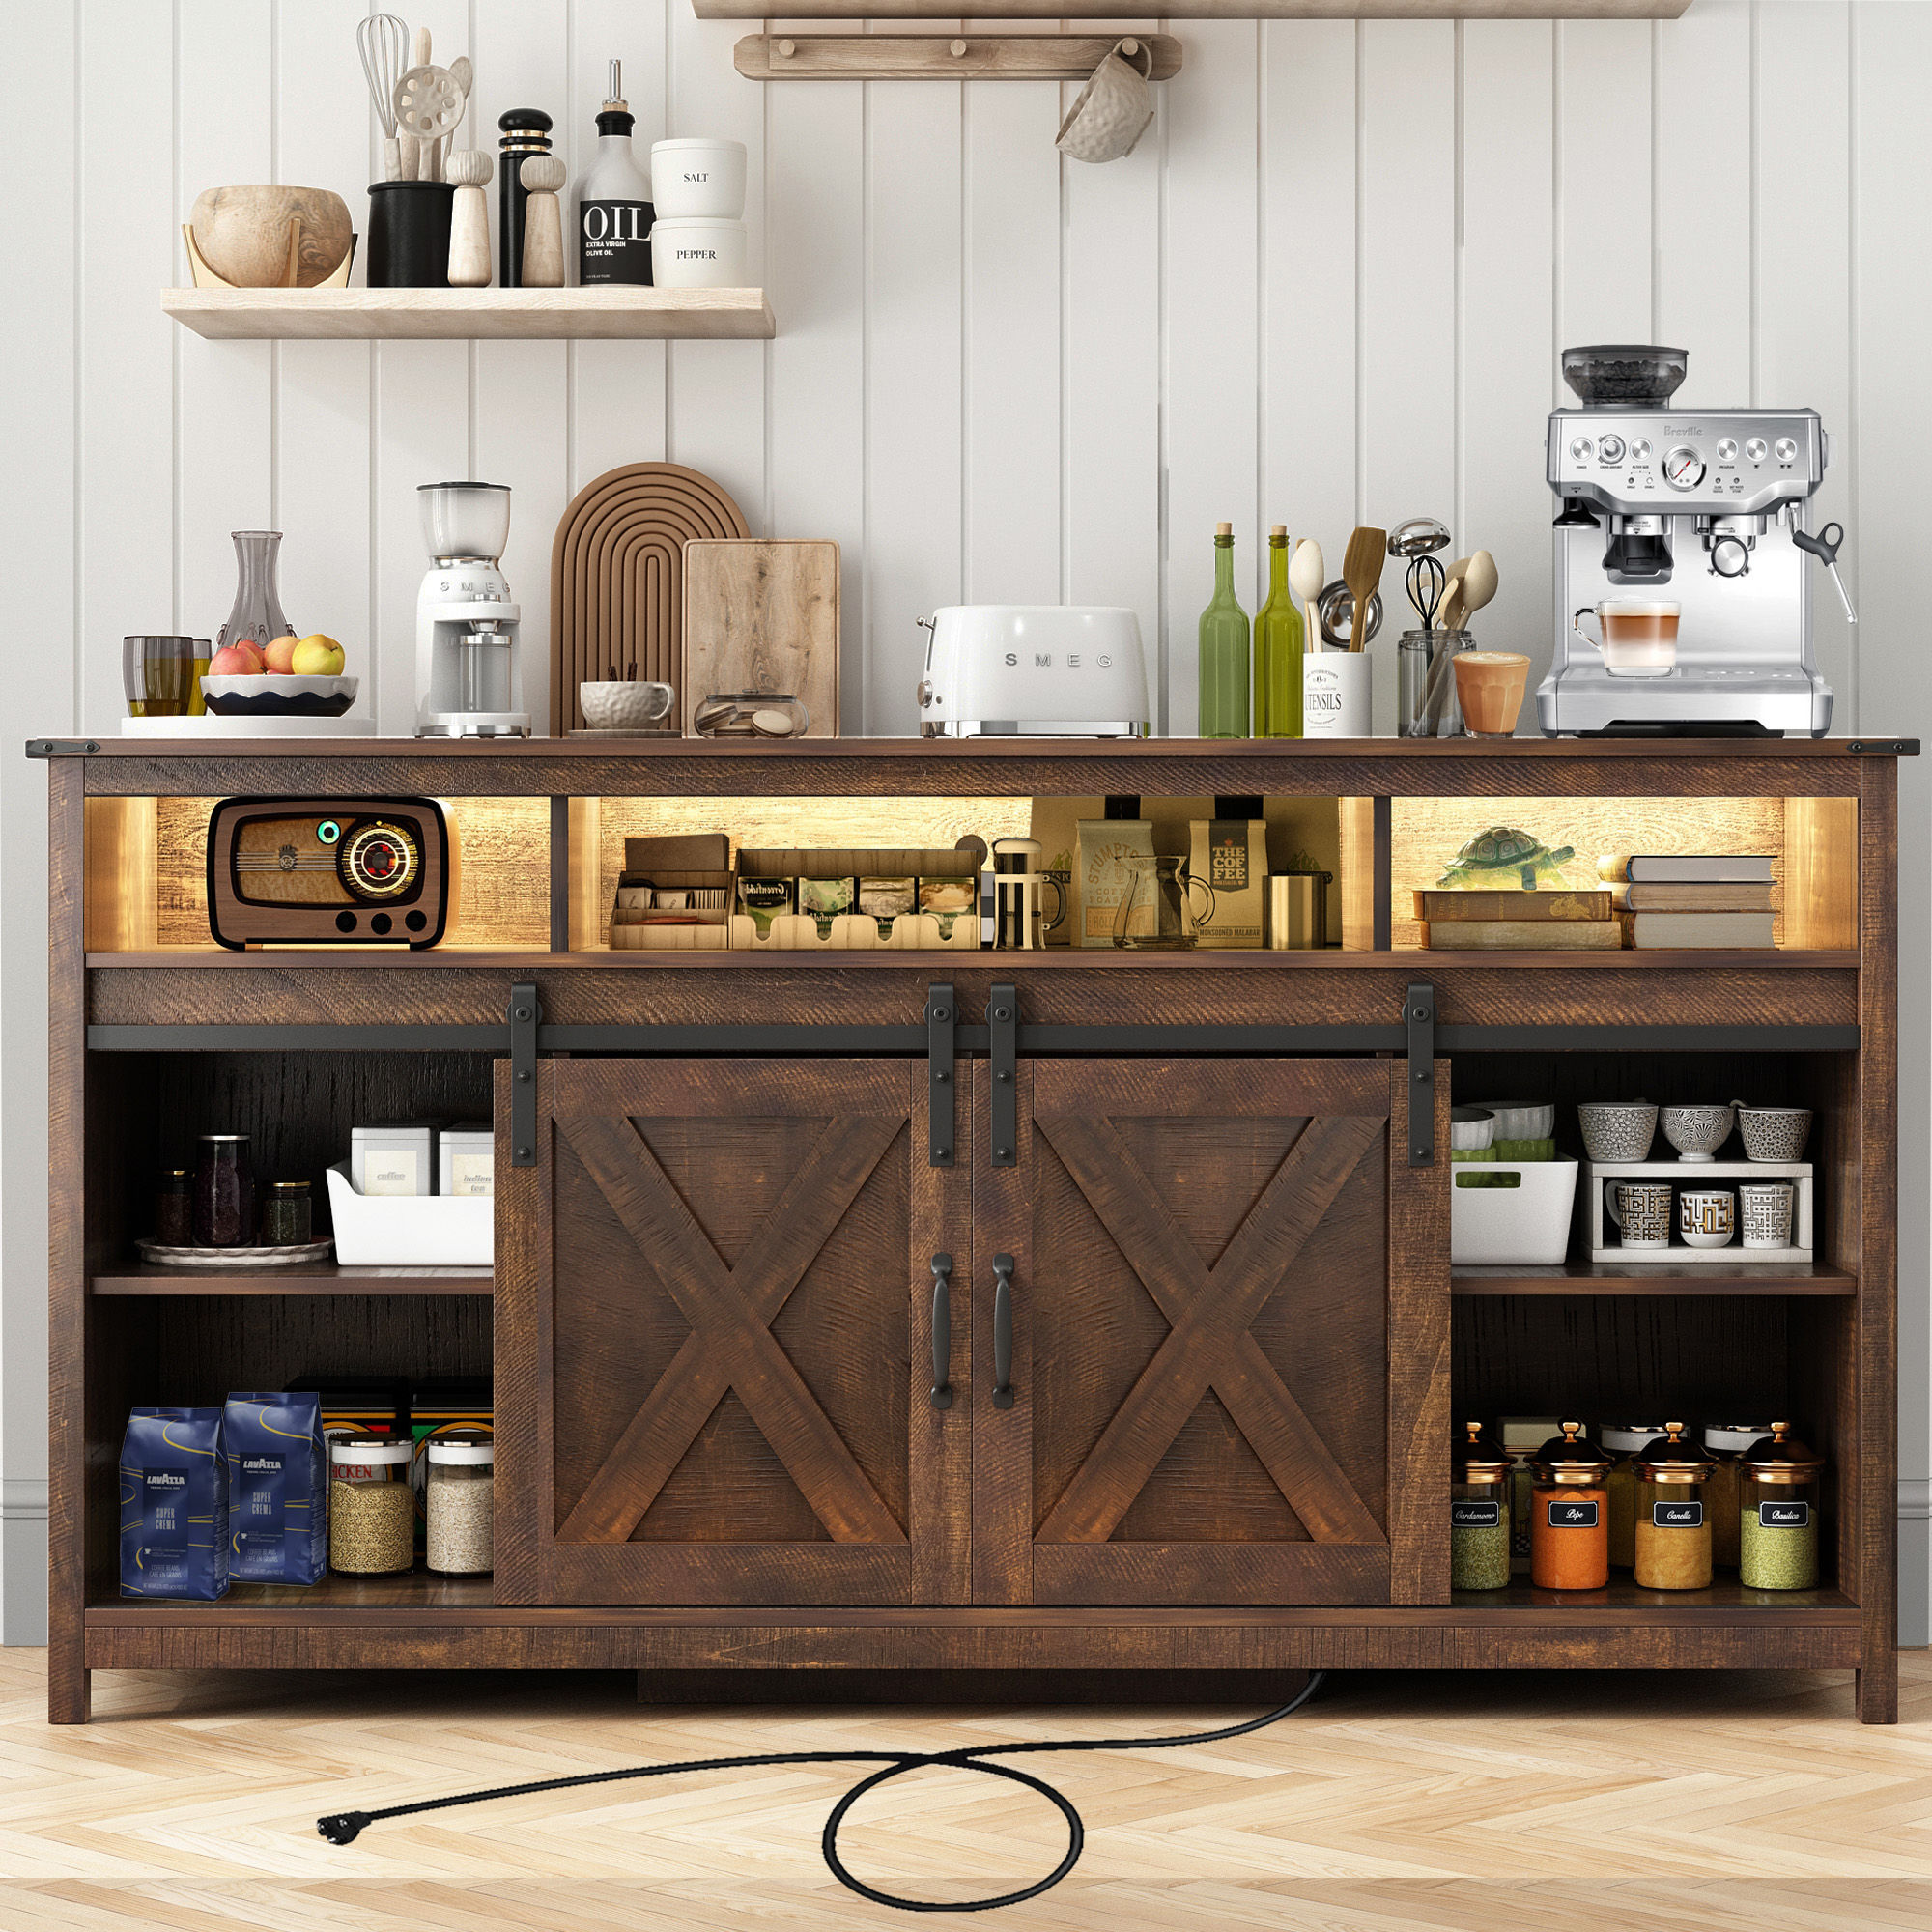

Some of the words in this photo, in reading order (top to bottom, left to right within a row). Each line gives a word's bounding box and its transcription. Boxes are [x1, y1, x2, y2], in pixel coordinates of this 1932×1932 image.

[683, 173, 708, 182] SALT
[583, 206, 651, 242] OIL
[676, 250, 717, 259] PEPPER
[1663, 425, 1703, 436] Breville
[440, 582, 511, 592] SMEG
[1005, 652, 1112, 667] SMEG
[1212, 847, 1246, 857] THE
[1212, 858, 1246, 868] COF
[1213, 868, 1246, 880] FEE
[1199, 928, 1234, 937] MONSOONED
[1235, 928, 1261, 937] MALABAR
[377, 1171, 406, 1180] coffee
[243, 1458, 282, 1469] LAVAZZA
[147, 1473, 185, 1485] LAVAZZA
[252, 1492, 271, 1503] SUPER
[156, 1507, 175, 1519] SUPER
[251, 1503, 272, 1515] CREMA
[155, 1520, 176, 1531] CREMA
